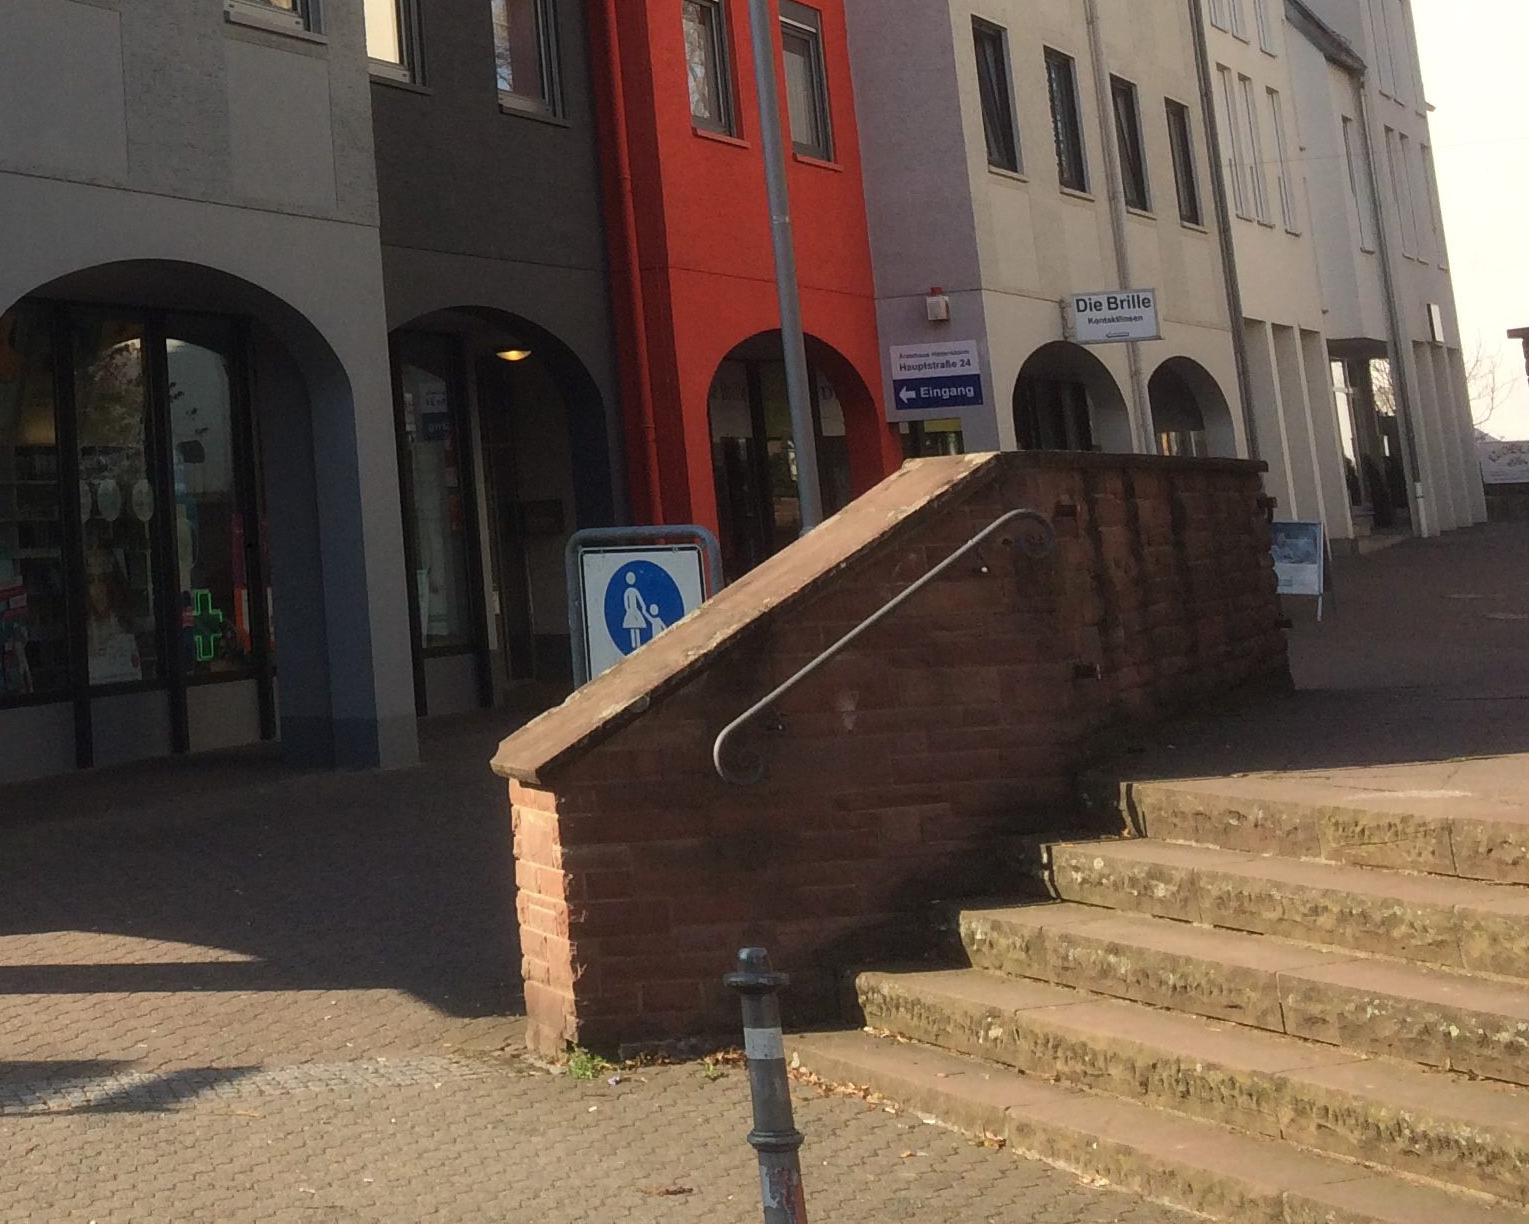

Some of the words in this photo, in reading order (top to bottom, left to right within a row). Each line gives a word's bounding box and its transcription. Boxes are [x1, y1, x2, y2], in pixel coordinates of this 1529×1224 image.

[1075, 298, 1103, 313] Die
[1107, 294, 1152, 311] Brille
[1088, 315, 1144, 325] Kontaktlinsen
[899, 359, 957, 372] Hauptstraße
[959, 358, 972, 368] 24
[920, 386, 975, 399] Eingang
